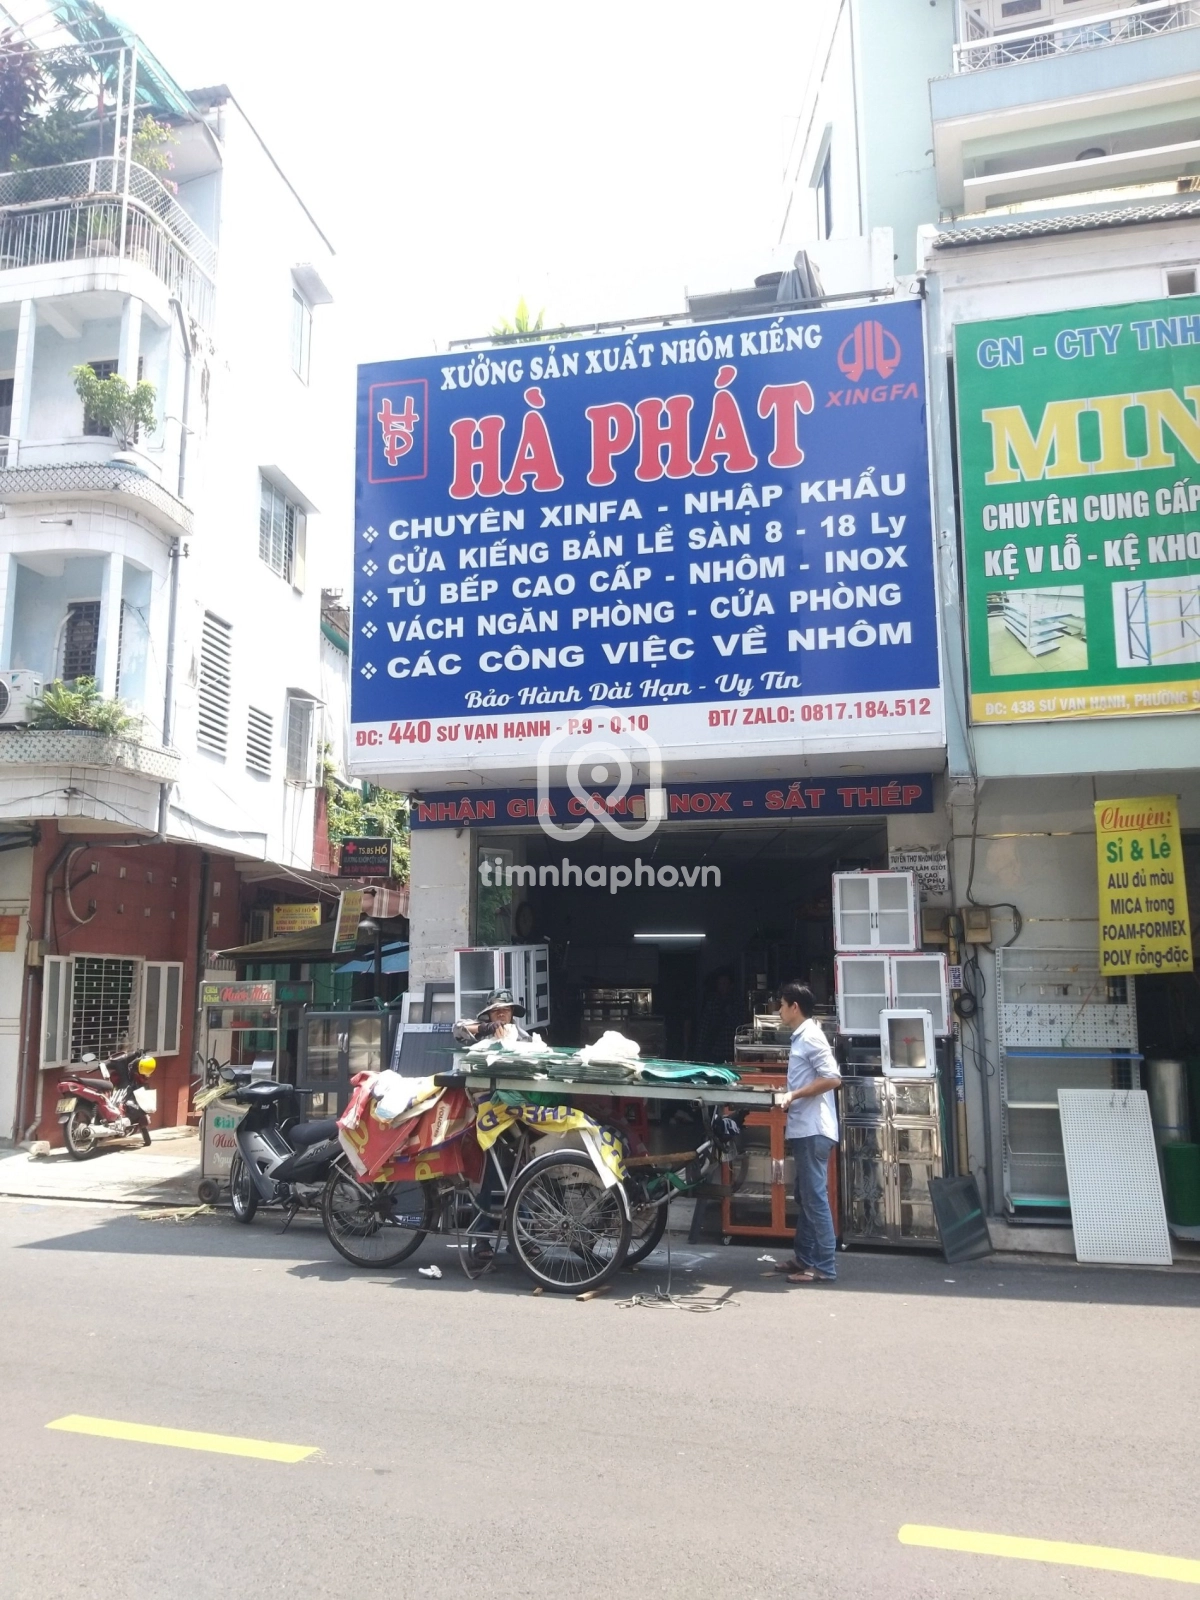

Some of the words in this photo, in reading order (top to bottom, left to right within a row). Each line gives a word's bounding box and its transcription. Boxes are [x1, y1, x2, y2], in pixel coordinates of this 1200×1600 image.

[440, 353, 524, 390] XƯỞNG
[529, 345, 579, 380] SẢN
[585, 334, 654, 374] XUẤT
[660, 330, 734, 366] NHÔM
[739, 317, 822, 357] KIẾNG
[977, 336, 1024, 368] CN
[1033, 347, 1046, 356] -
[1055, 324, 1122, 359] CTY
[825, 382, 918, 408] XINGFA
[449, 386, 564, 500] HÀ
[585, 364, 814, 487] PHÁT
[388, 507, 525, 541] CHUYÊN
[539, 499, 643, 528] XINFA
[684, 482, 783, 516] NHẬP
[800, 466, 906, 504] KHẨU
[982, 493, 1078, 532] CHUYÊN
[1083, 490, 1150, 522] CUNG
[387, 545, 446, 575] CỬA
[459, 538, 549, 569] KIẾNG
[562, 530, 623, 561] BẢN
[637, 523, 674, 555] LỀ
[688, 521, 750, 550] SÀN
[765, 520, 782, 543] 8
[820, 514, 856, 538] 18
[870, 512, 907, 538] Ly
[984, 543, 1019, 580] KỆ
[1024, 546, 1044, 573] V
[1050, 533, 1081, 572] LỖ
[1104, 533, 1141, 571] KỆ
[387, 578, 426, 608] TỦ
[440, 573, 498, 604] BẾP
[512, 573, 576, 599] CAO
[589, 561, 651, 593] CẤP
[665, 574, 675, 582] -
[689, 553, 785, 584] NHÔM
[825, 545, 908, 573] INOX
[387, 614, 464, 643] VÁCH
[477, 607, 558, 636] NGĂN
[572, 600, 674, 630] PHÒNG
[710, 588, 775, 619] CỬA
[789, 581, 902, 613] PHÒNG
[387, 649, 462, 679] CÁC
[479, 644, 584, 673] CÔNG
[601, 635, 695, 668] VIỆC
[712, 624, 767, 657] VỀ
[787, 619, 912, 652] NHÔM
[464, 688, 514, 708] Bảo
[517, 684, 583, 705] Hành
[588, 681, 634, 701] Dài
[639, 679, 692, 701] Hạn
[715, 674, 754, 697] Uy
[760, 670, 802, 690] Tín
[985, 703, 1007, 716] ĐC:
[1011, 701, 1035, 714] 438
[1039, 698, 1056, 712] SƯ
[1060, 697, 1085, 713] VẠN
[1134, 689, 1188, 708] PHƯỜNG
[356, 730, 383, 746] ĐC:
[388, 720, 431, 744] 440
[436, 725, 462, 742] SƯ
[464, 723, 498, 744] VẠN
[504, 720, 550, 741] HẠNH
[568, 718, 593, 735] P.9
[610, 714, 649, 735] Q.10
[708, 709, 737, 727] ĐT/
[742, 706, 795, 725] ZALO:
[800, 697, 931, 722] 0817.184.512
[418, 797, 496, 825] NHẬN
[507, 798, 557, 817] GIA
[668, 792, 733, 813] NOX
[765, 782, 825, 810] SẮT
[837, 781, 923, 808] THÉP
[1101, 807, 1171, 831] Chuyên:
[1106, 837, 1123, 864] Sỉ
[1130, 839, 1144, 861] &
[1150, 833, 1171, 860] Lẻ
[1107, 872, 1129, 890] ALU
[1132, 868, 1146, 887] đủ
[1150, 868, 1174, 886] màu
[1110, 898, 1142, 915] MICA
[1145, 897, 1175, 916] trong
[1102, 920, 1187, 942] FOAM-FORMEX
[1103, 949, 1132, 966] POLY
